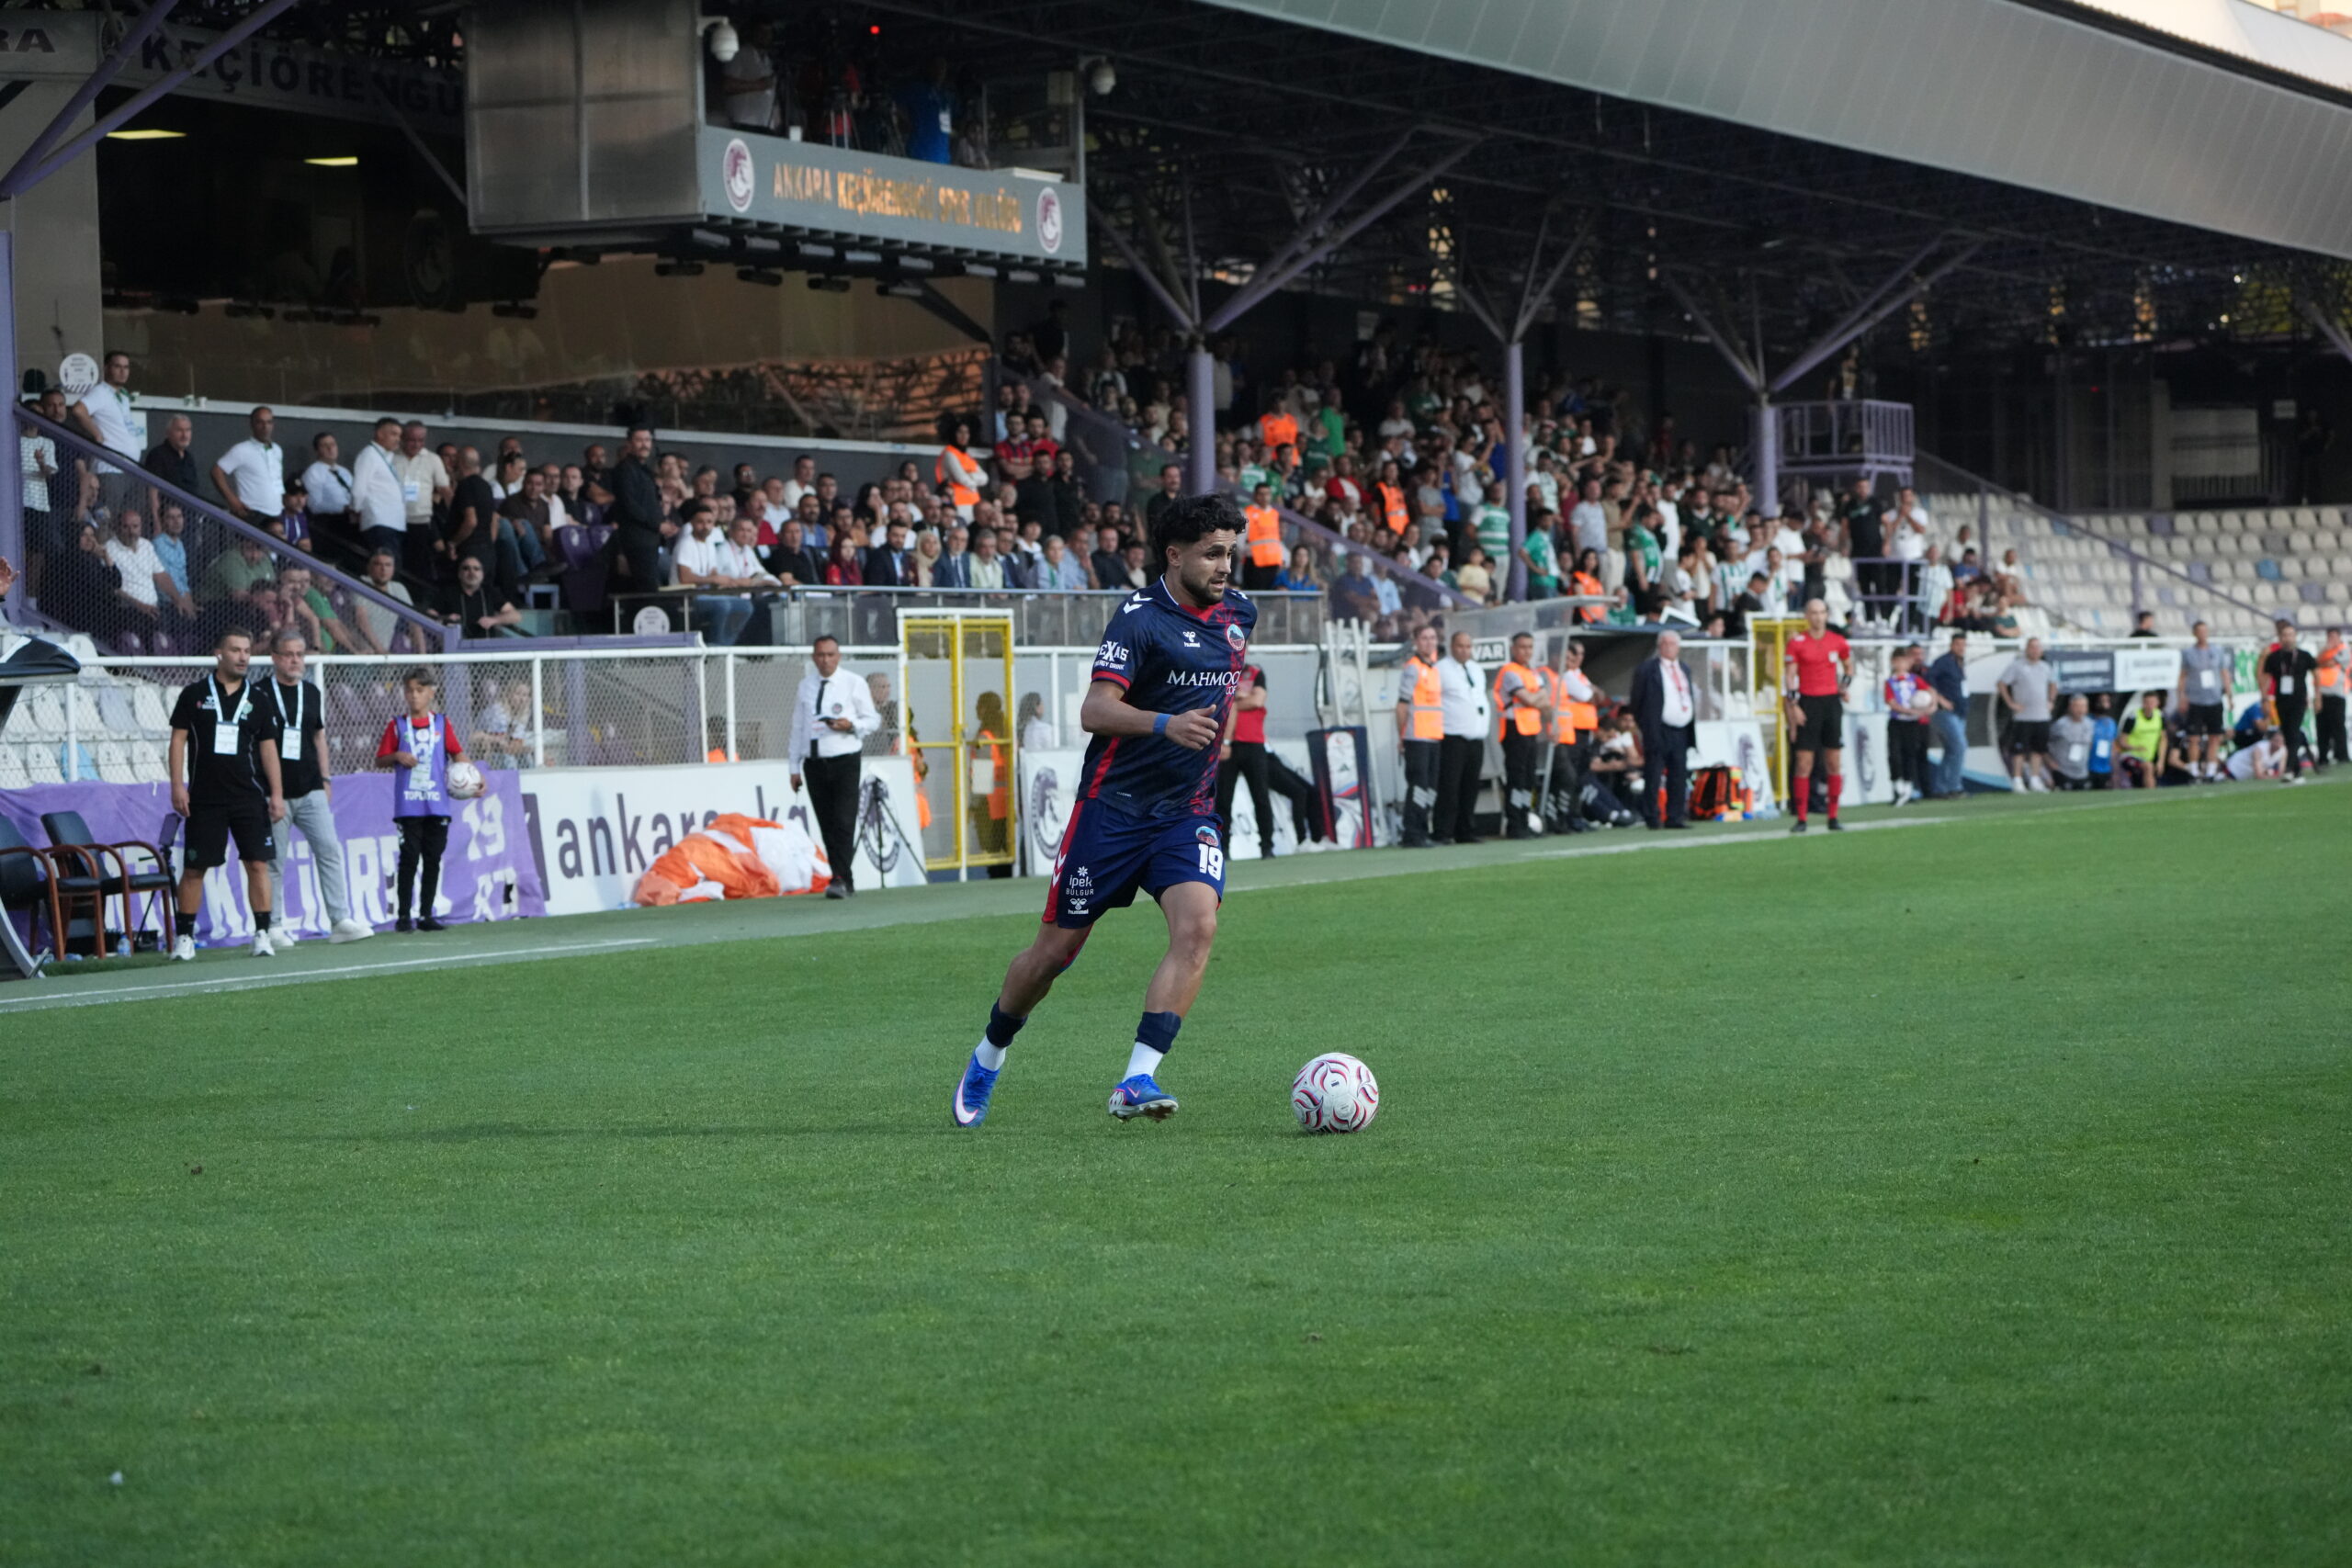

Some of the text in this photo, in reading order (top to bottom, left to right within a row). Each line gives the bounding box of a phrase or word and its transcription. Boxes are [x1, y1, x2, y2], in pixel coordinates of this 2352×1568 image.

[774, 164, 831, 201] ANKARA
[1098, 640, 1129, 661] EXAS
[1474, 643, 1504, 660] VAR
[1166, 670, 1242, 686] MAHMOO
[462, 794, 505, 862] 19
[1198, 843, 1224, 881] 19
[1069, 874, 1092, 889] ipek
[1066, 887, 1094, 897] BULGUR
